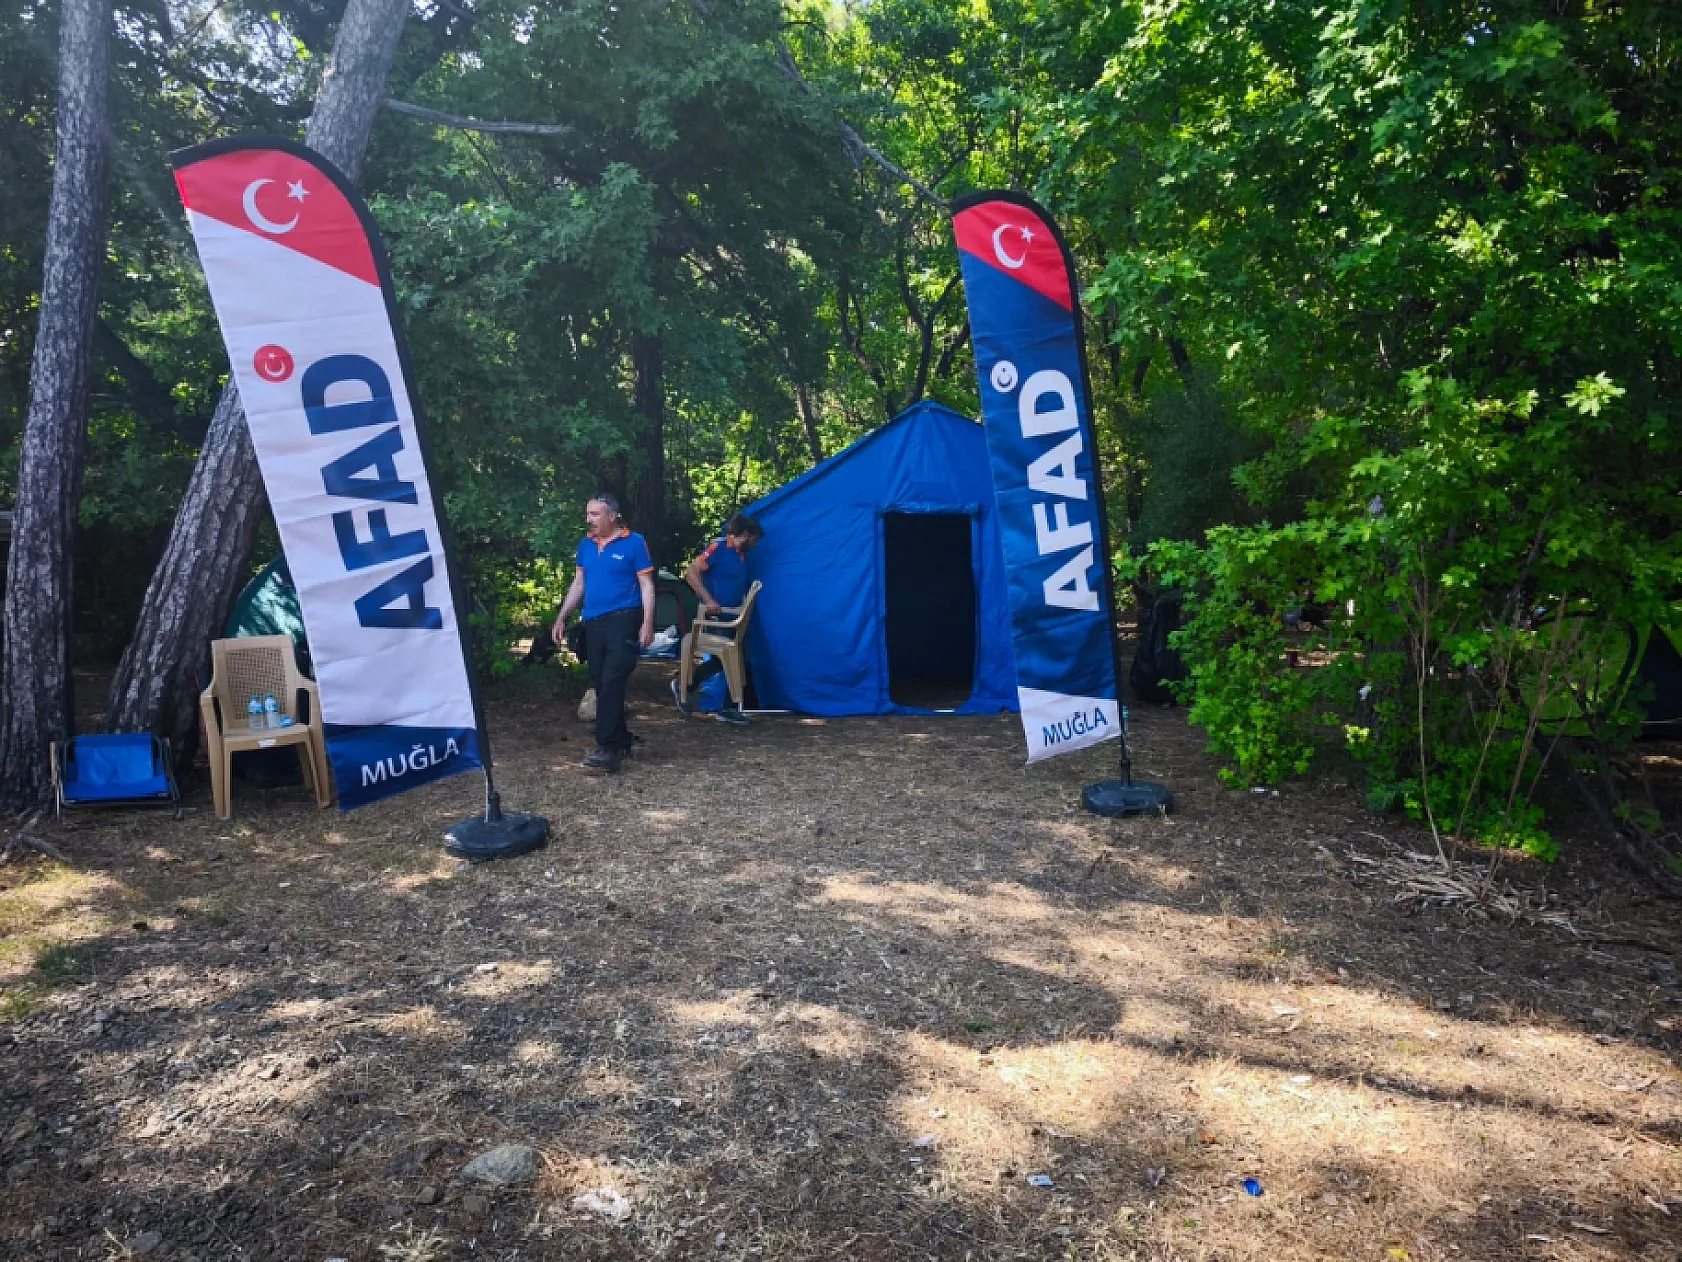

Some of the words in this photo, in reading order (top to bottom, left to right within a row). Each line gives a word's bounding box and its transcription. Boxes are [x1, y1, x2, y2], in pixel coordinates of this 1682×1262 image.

[301, 354, 442, 629] AFAD
[1019, 369, 1099, 612] AFAD
[360, 736, 460, 787] MUĞLA
[1042, 706, 1108, 747] MUĞLA
